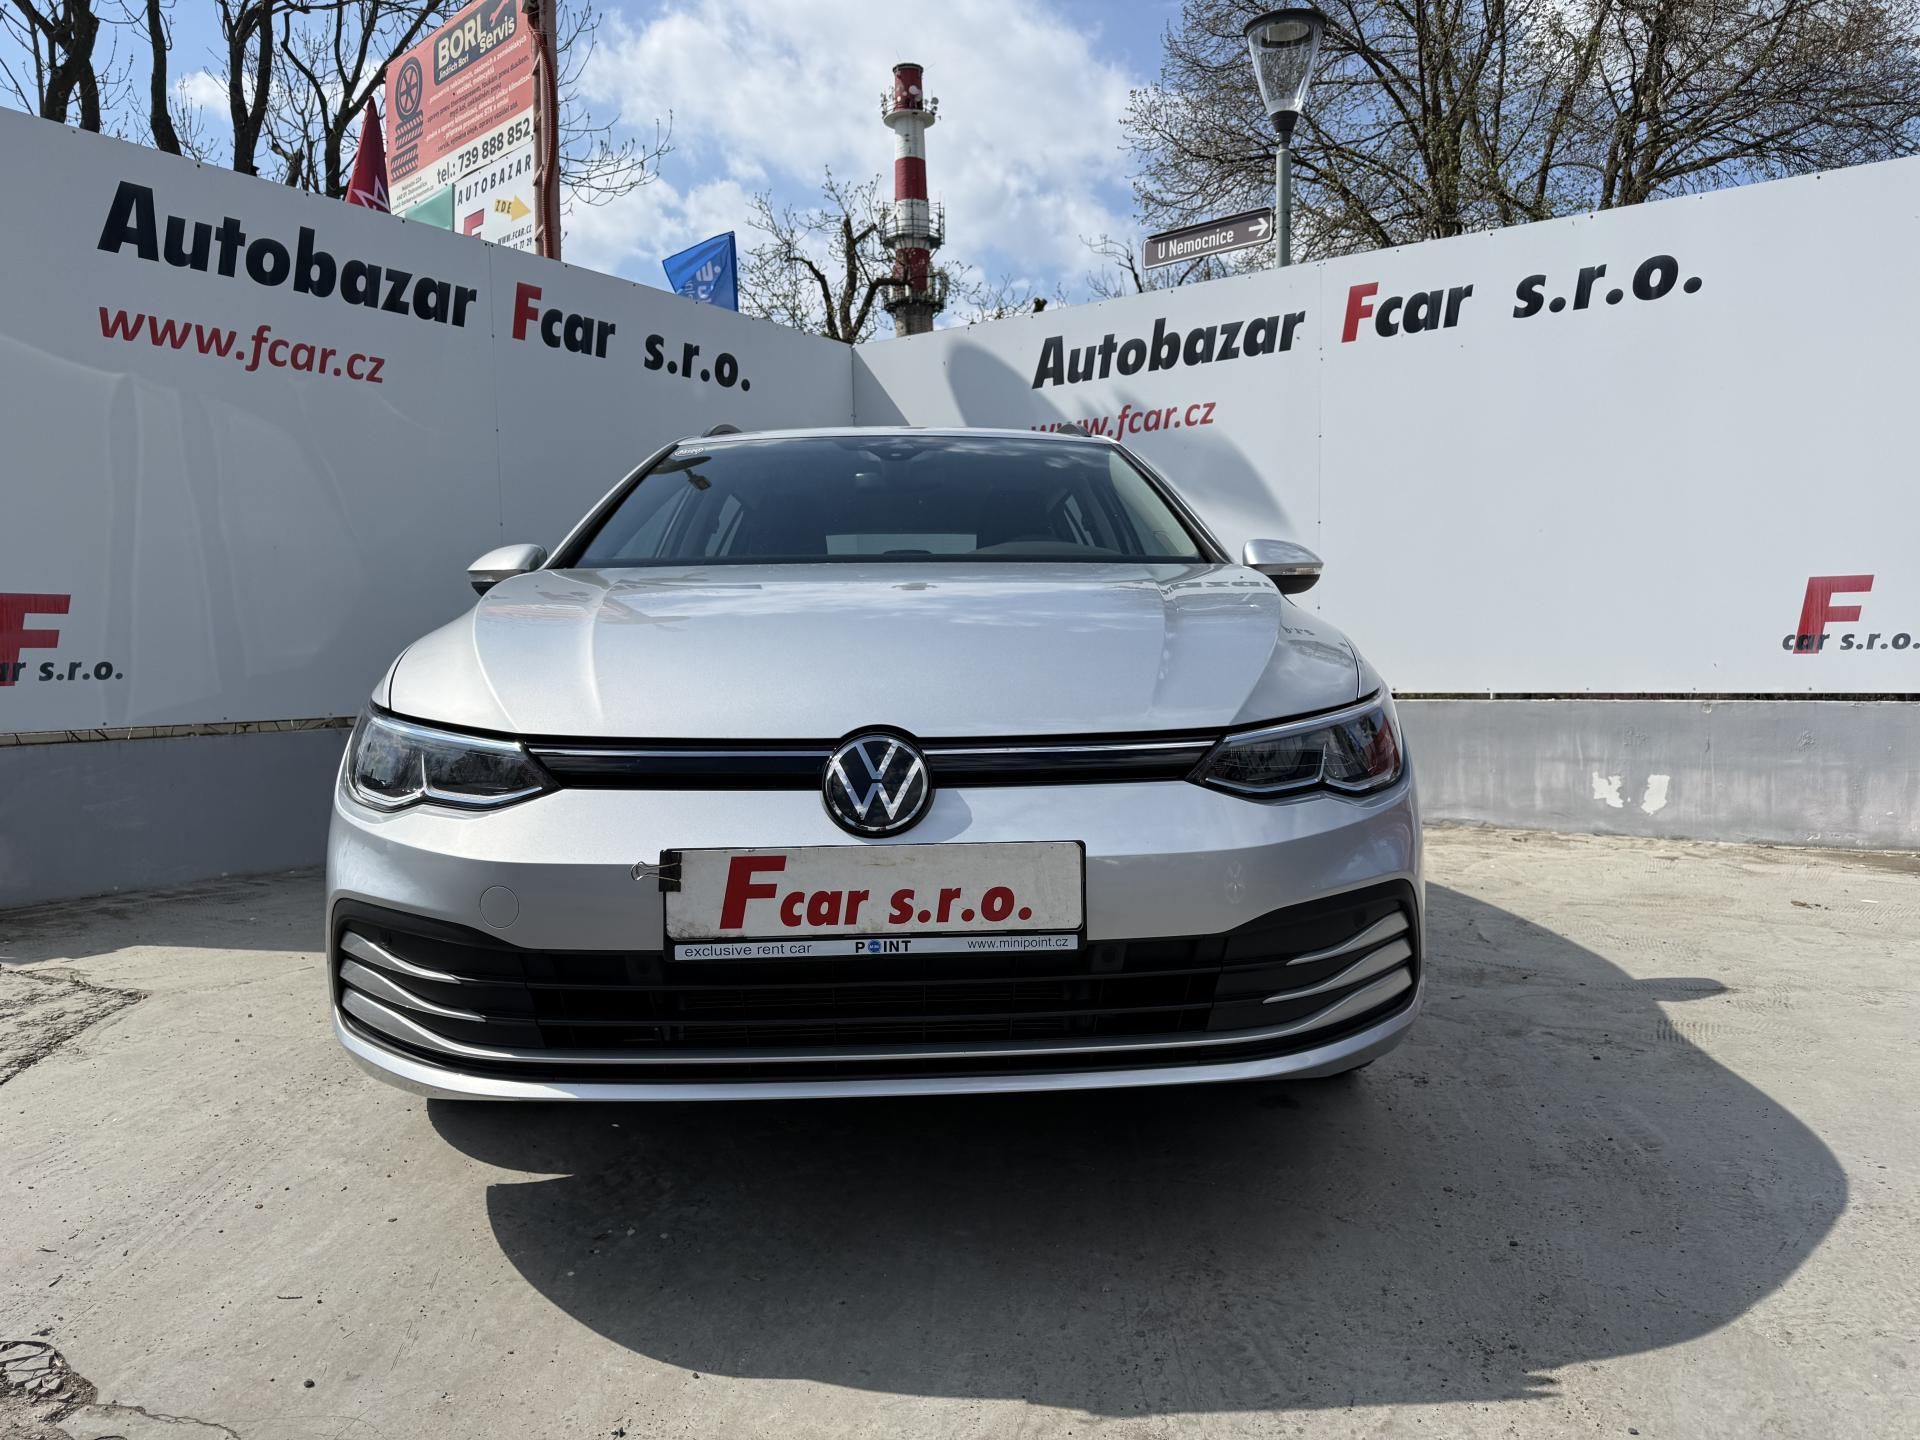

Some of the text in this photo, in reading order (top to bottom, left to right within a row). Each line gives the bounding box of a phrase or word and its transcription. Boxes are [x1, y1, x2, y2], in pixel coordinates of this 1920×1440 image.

[479, 16, 515, 54] servis
[458, 149, 479, 172] 739
[482, 134, 504, 160] 888
[507, 118, 531, 143] 852
[457, 153, 532, 206] AUTOBAZAR
[495, 199, 512, 214] ZDE
[1157, 229, 1234, 259] U Nemocnice
[97, 180, 752, 392] Autobazar Fcar s.r.o.
[1031, 254, 1704, 390] Autobazar Fcar s.r.o.
[99, 306, 386, 385] www.fcar.cz
[1031, 402, 1217, 441] w.fcar.cz
[1839, 632, 1920, 651] s.r.o.
[38, 661, 124, 682] s.r.o.
[719, 855, 1033, 930] Fcar s.r.o.
[684, 943, 813, 958] exclusive rent car
[967, 937, 1069, 951] www.minipoint.cz
